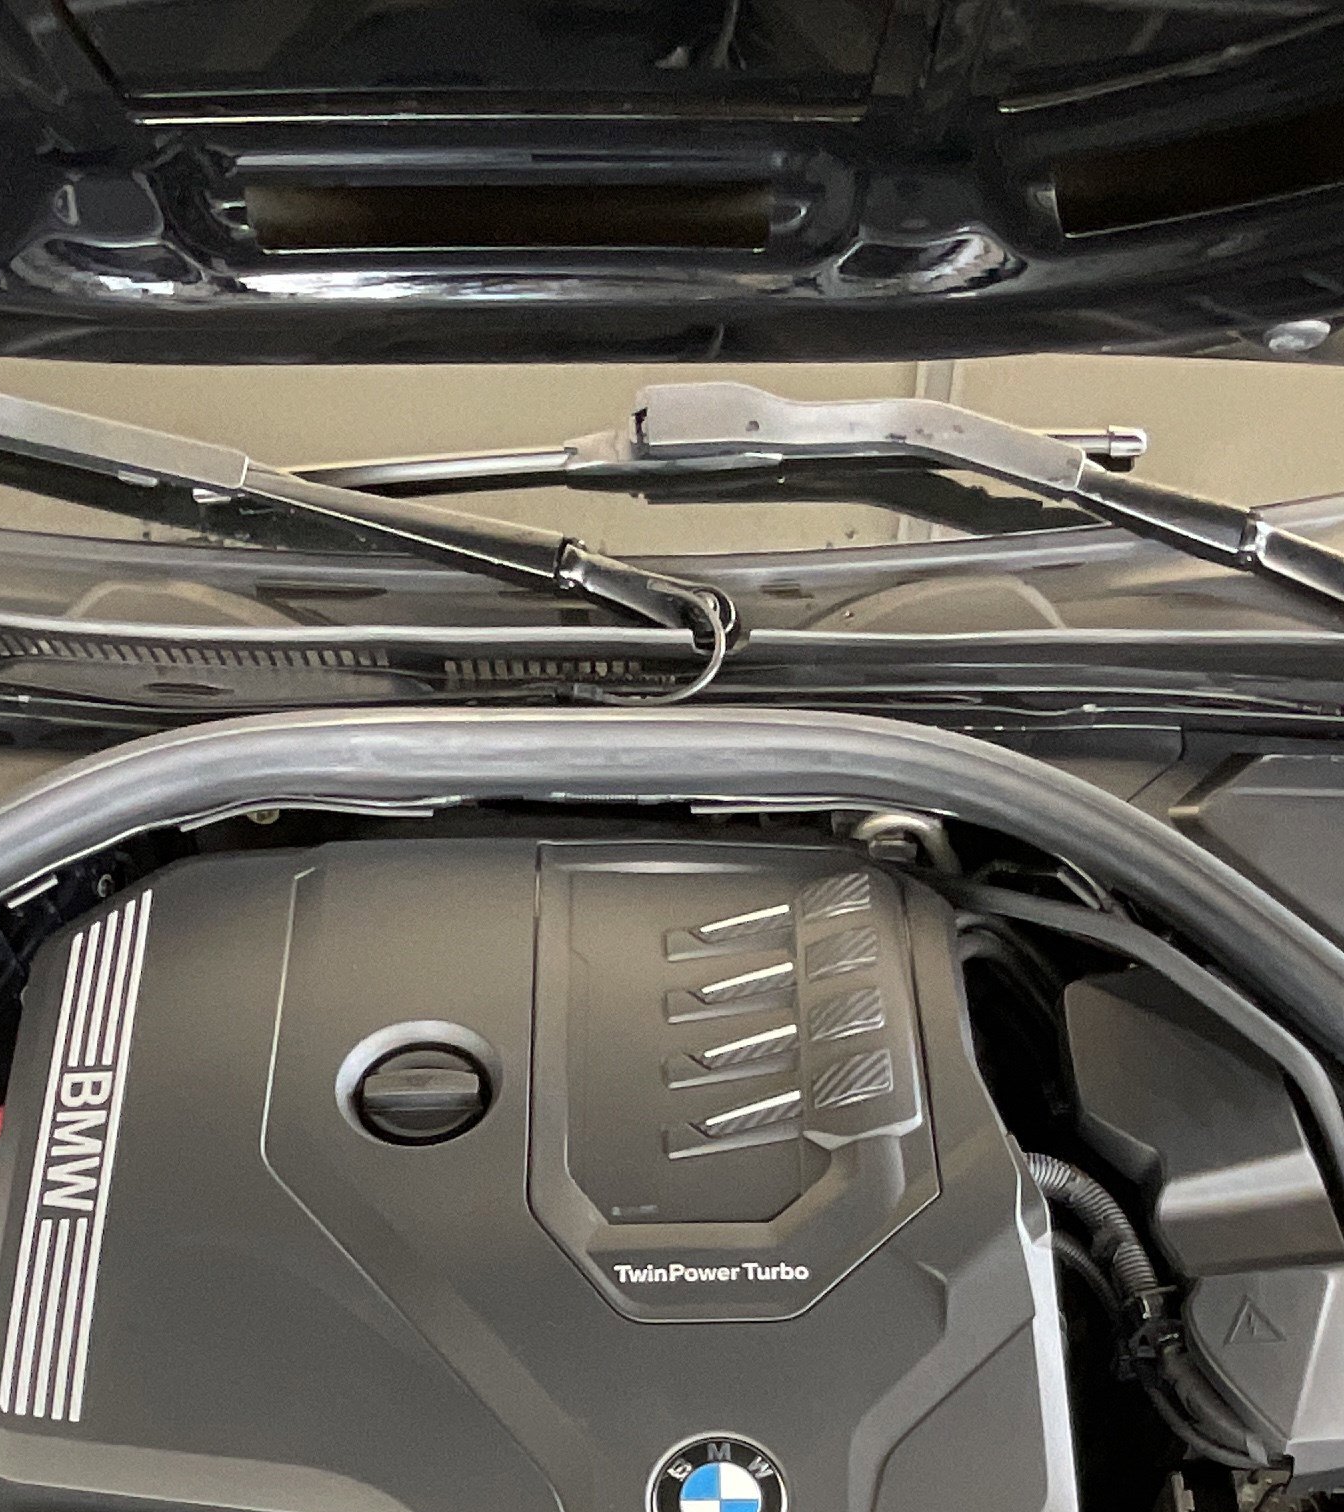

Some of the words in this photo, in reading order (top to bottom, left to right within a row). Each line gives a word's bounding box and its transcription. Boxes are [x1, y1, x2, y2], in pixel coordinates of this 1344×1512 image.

[42, 1071, 113, 1211] BMW
[613, 1263, 740, 1283] TwinPower
[741, 1262, 810, 1281] Turbo
[667, 1442, 773, 1482] BMW
